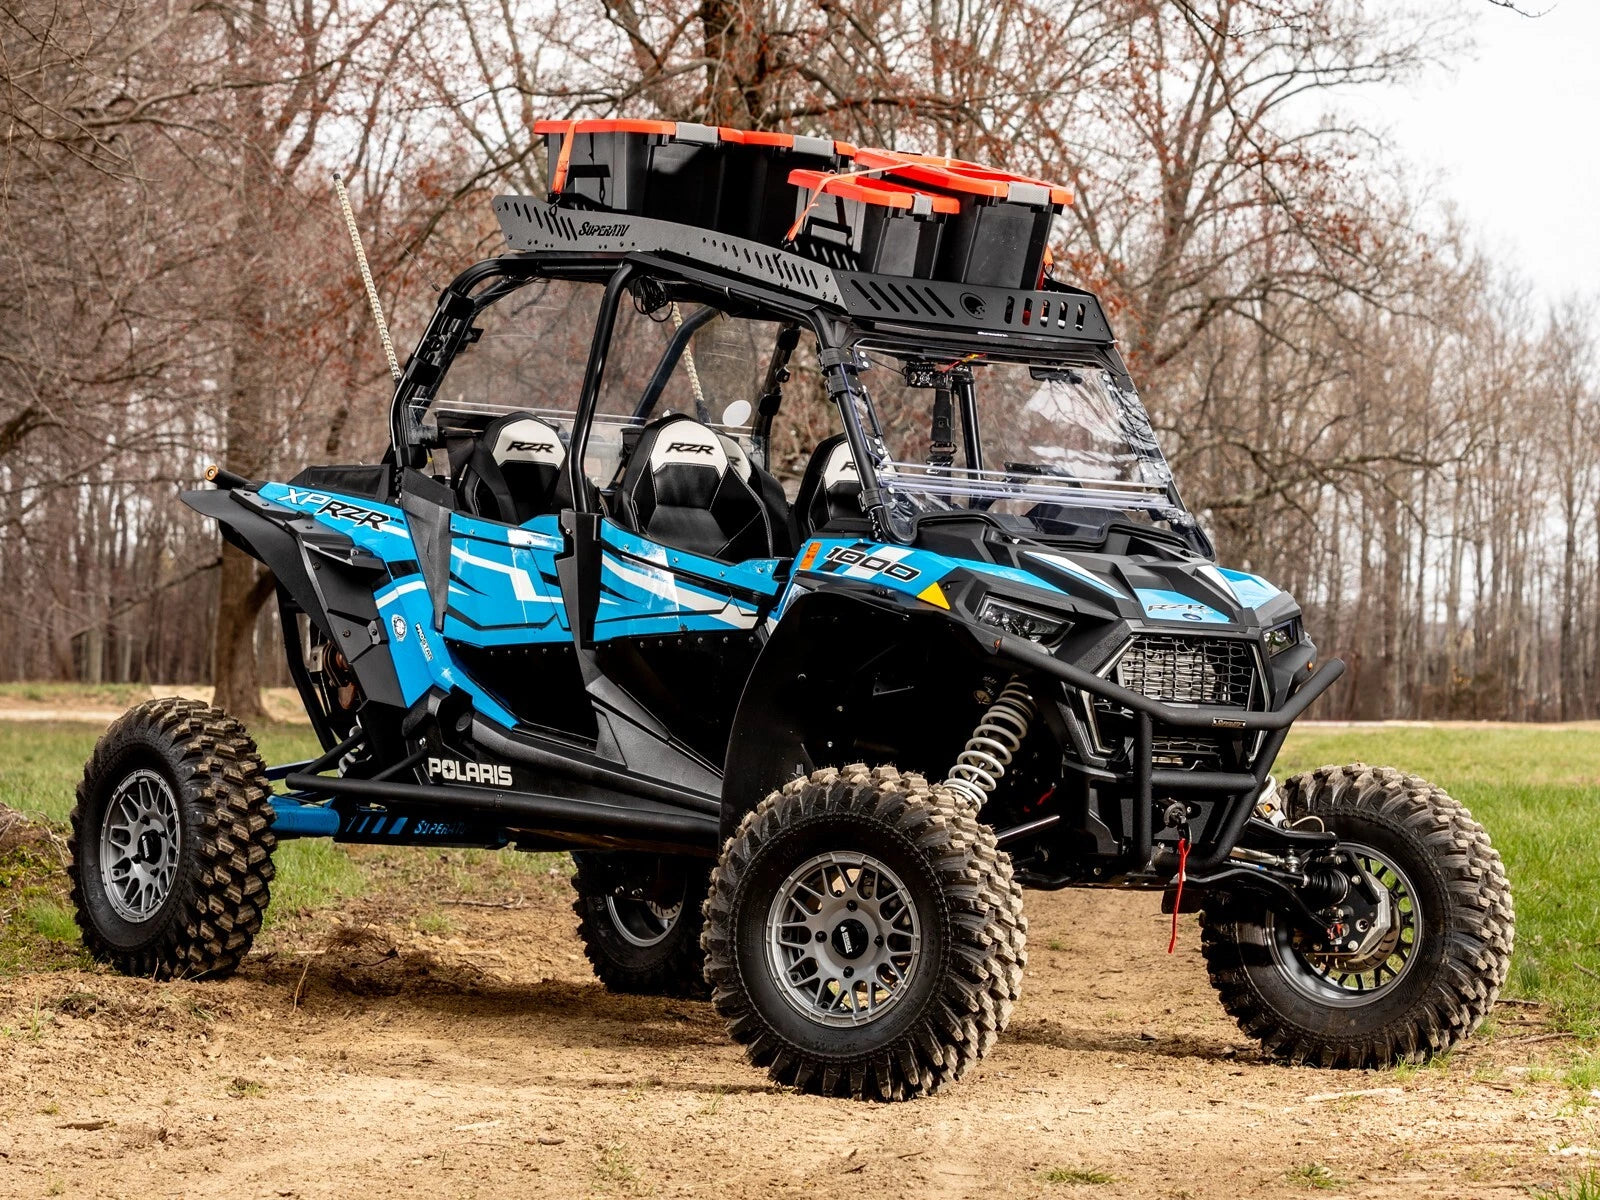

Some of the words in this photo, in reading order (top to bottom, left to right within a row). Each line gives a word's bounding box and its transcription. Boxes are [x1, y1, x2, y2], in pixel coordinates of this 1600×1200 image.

[506, 440, 555, 454] RZR
[665, 442, 715, 456] RZR
[275, 487, 333, 506] XP
[314, 500, 391, 532] RZR
[824, 546, 922, 582] 1000
[427, 757, 513, 787] POLARIS
